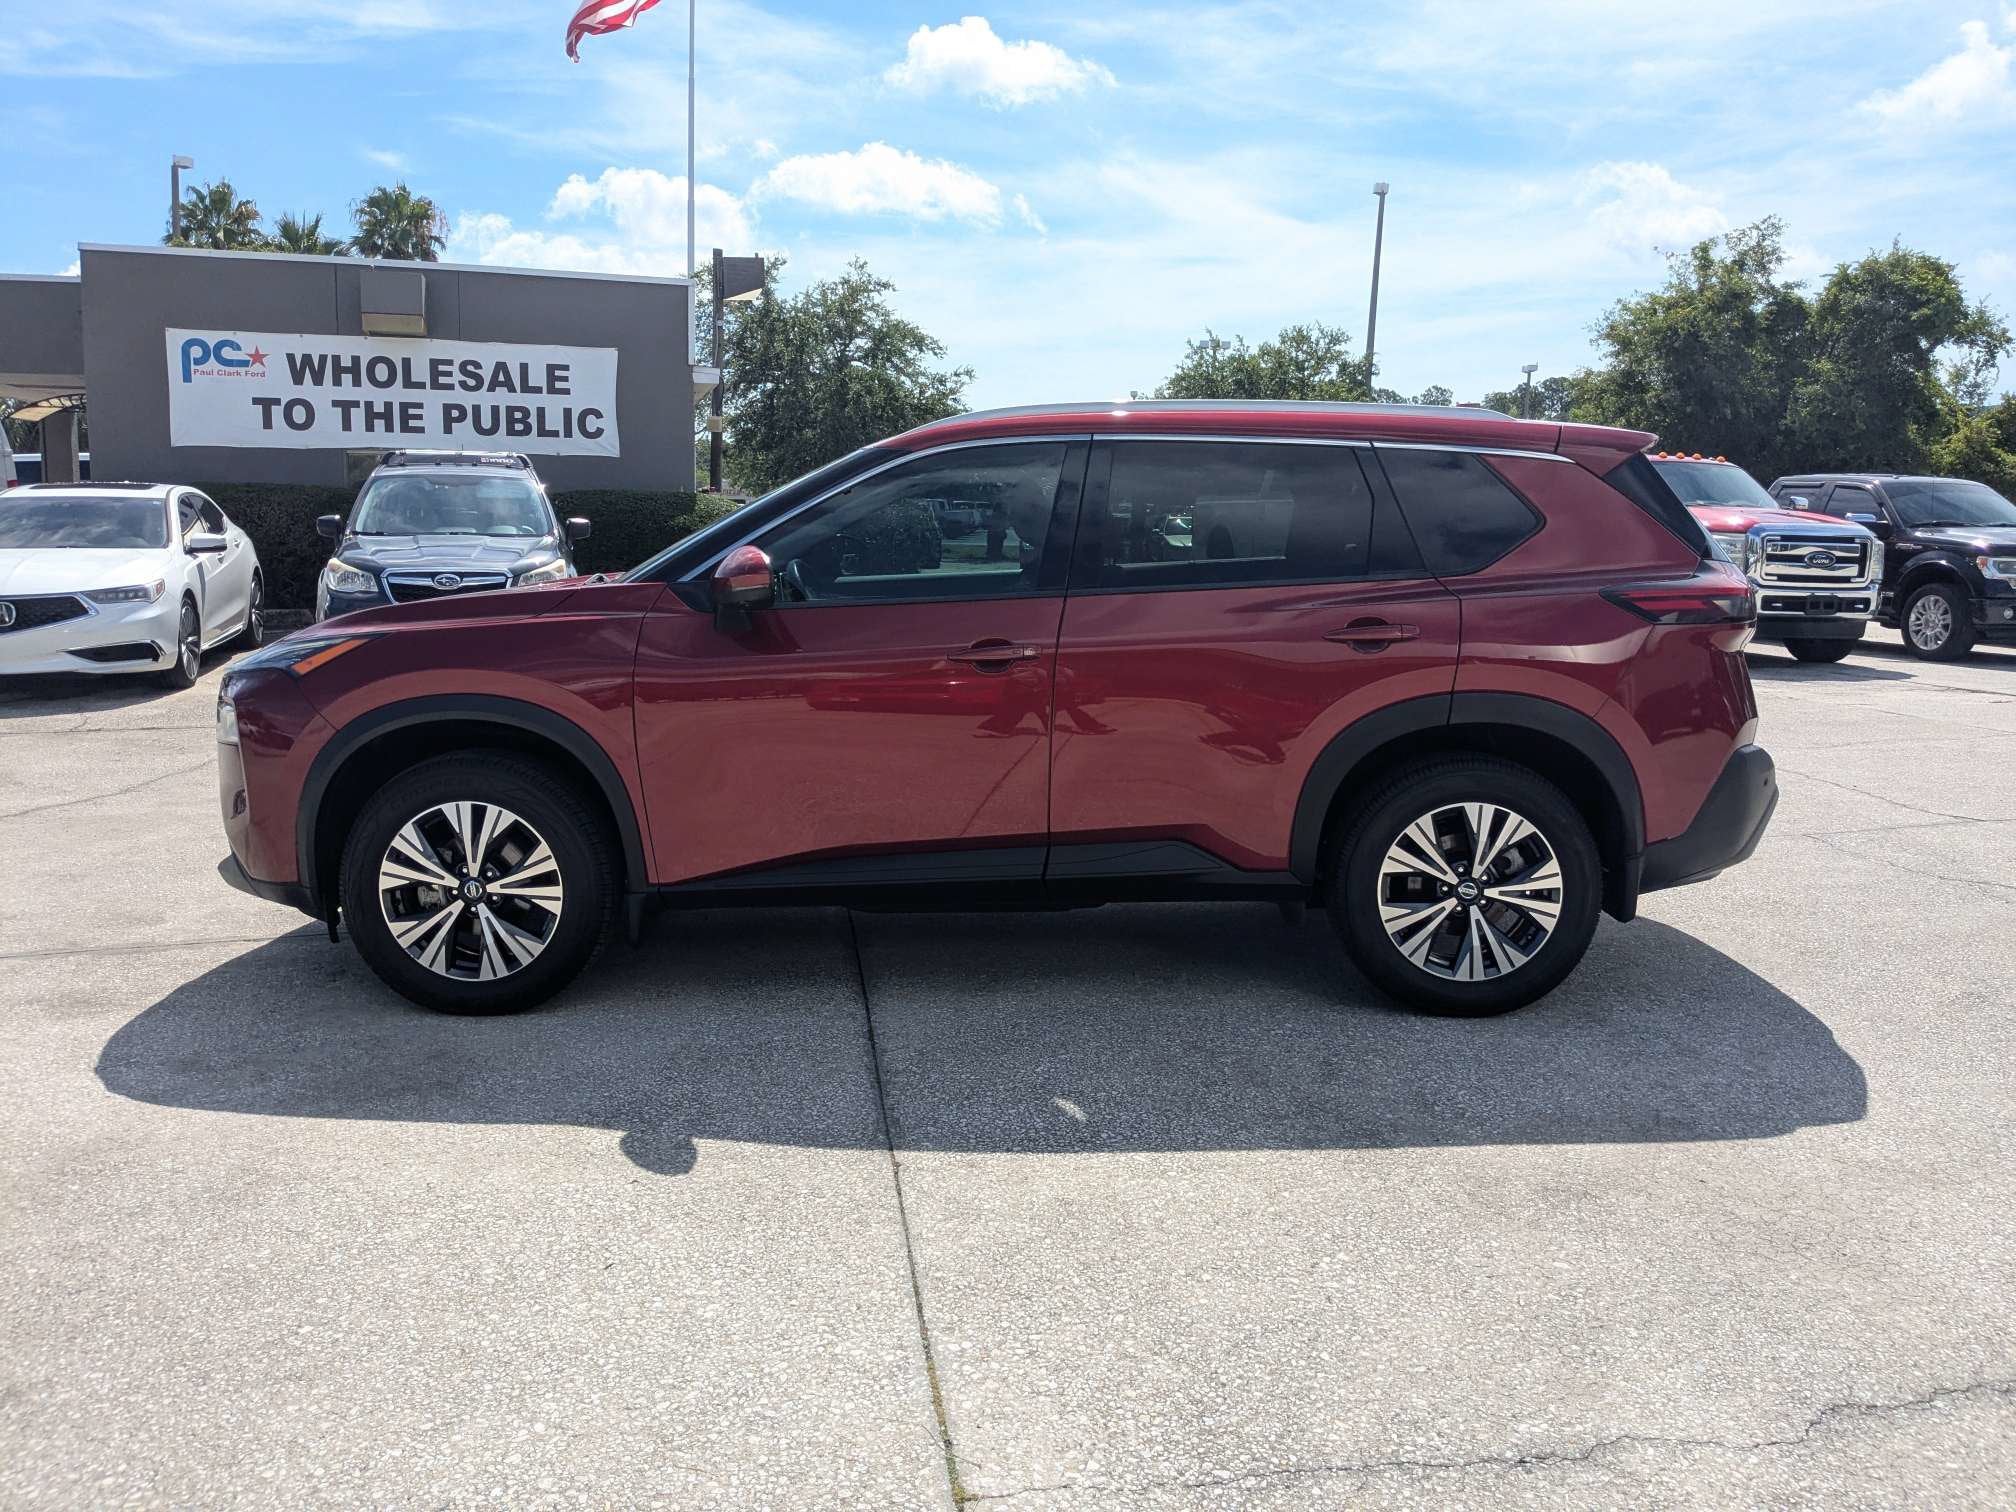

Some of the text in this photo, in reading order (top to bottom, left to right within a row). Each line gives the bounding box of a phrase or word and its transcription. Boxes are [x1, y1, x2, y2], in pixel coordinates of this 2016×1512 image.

[193, 368, 266, 378] Paul Clark Ford
[286, 353, 571, 395] WHOLESALE
[252, 397, 604, 439] TO THE PUBLIC
